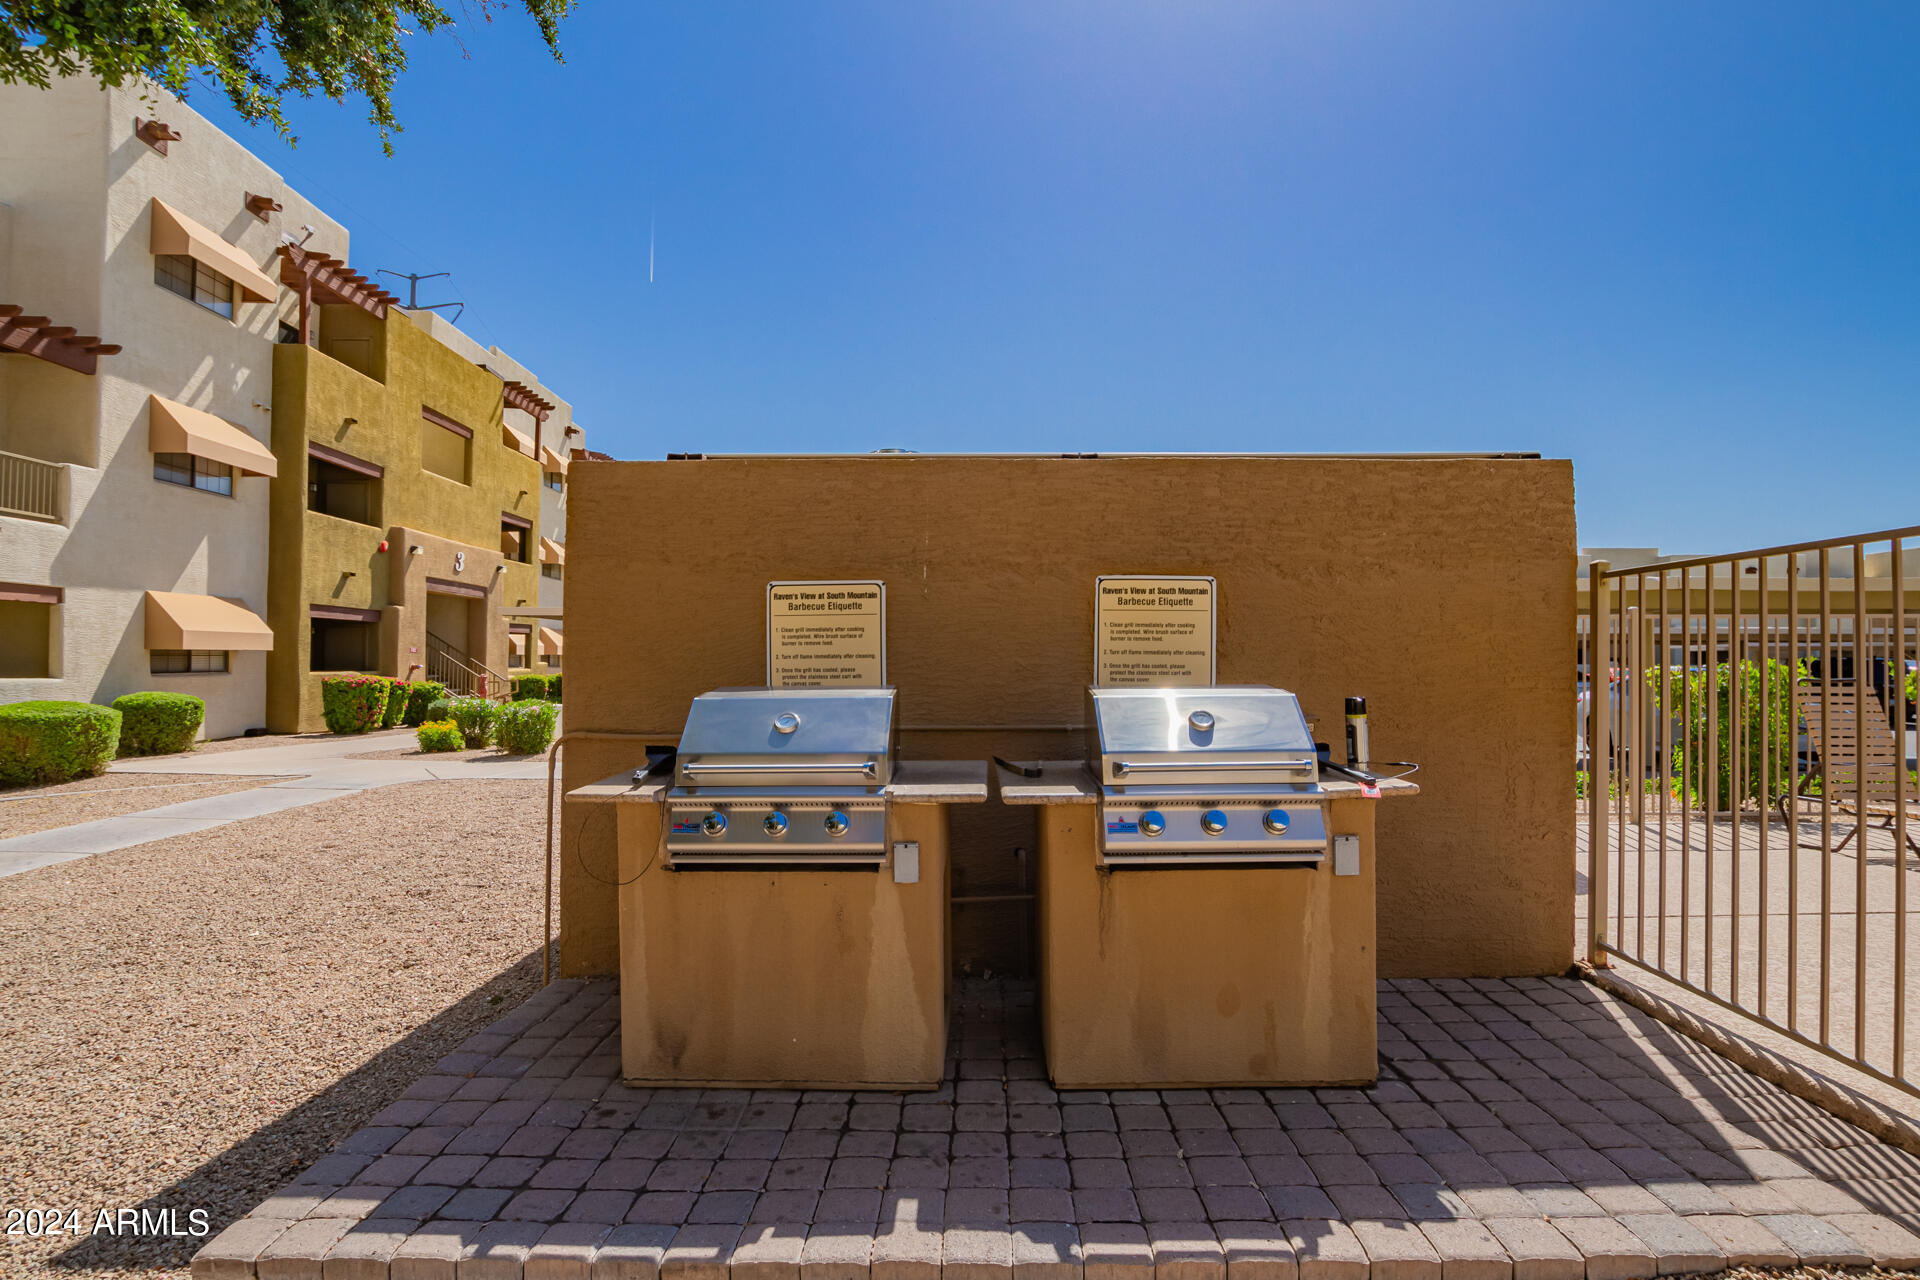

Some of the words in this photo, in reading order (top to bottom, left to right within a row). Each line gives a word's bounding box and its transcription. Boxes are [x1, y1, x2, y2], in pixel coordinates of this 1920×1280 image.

[455, 552, 465, 572] 3
[788, 603, 825, 611] Barbecue
[828, 602, 863, 612] Etiquette
[1118, 597, 1156, 606] Barbecue
[1158, 597, 1193, 607] Etiquette
